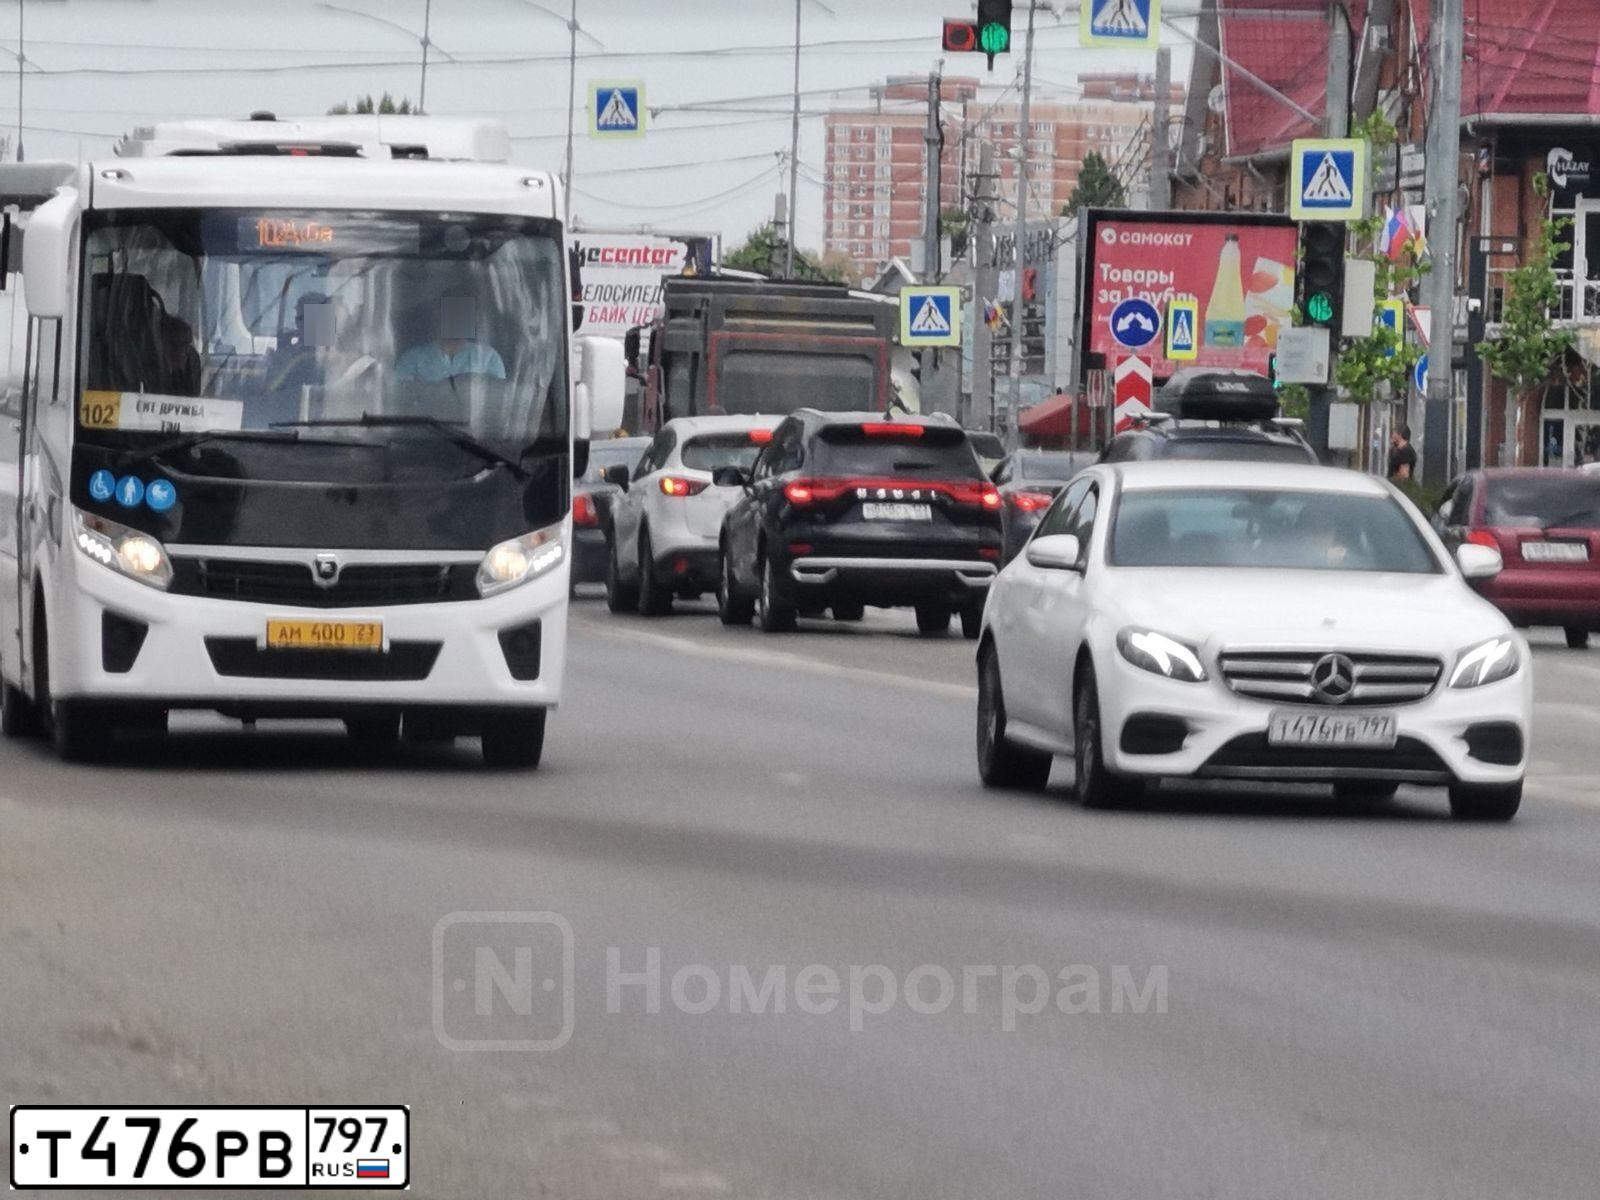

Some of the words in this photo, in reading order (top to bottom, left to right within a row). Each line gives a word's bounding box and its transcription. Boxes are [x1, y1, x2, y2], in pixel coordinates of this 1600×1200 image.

[1119, 231, 1193, 246] самокат
[1100, 263, 1175, 288] Товары
[581, 283, 662, 304] ЕЛОСИПЕД
[1098, 288, 1122, 304] за
[588, 305, 629, 323] БАЙК
[82, 403, 115, 425] 102
[278, 626, 302, 640] АМ
[310, 623, 346, 641] 400
